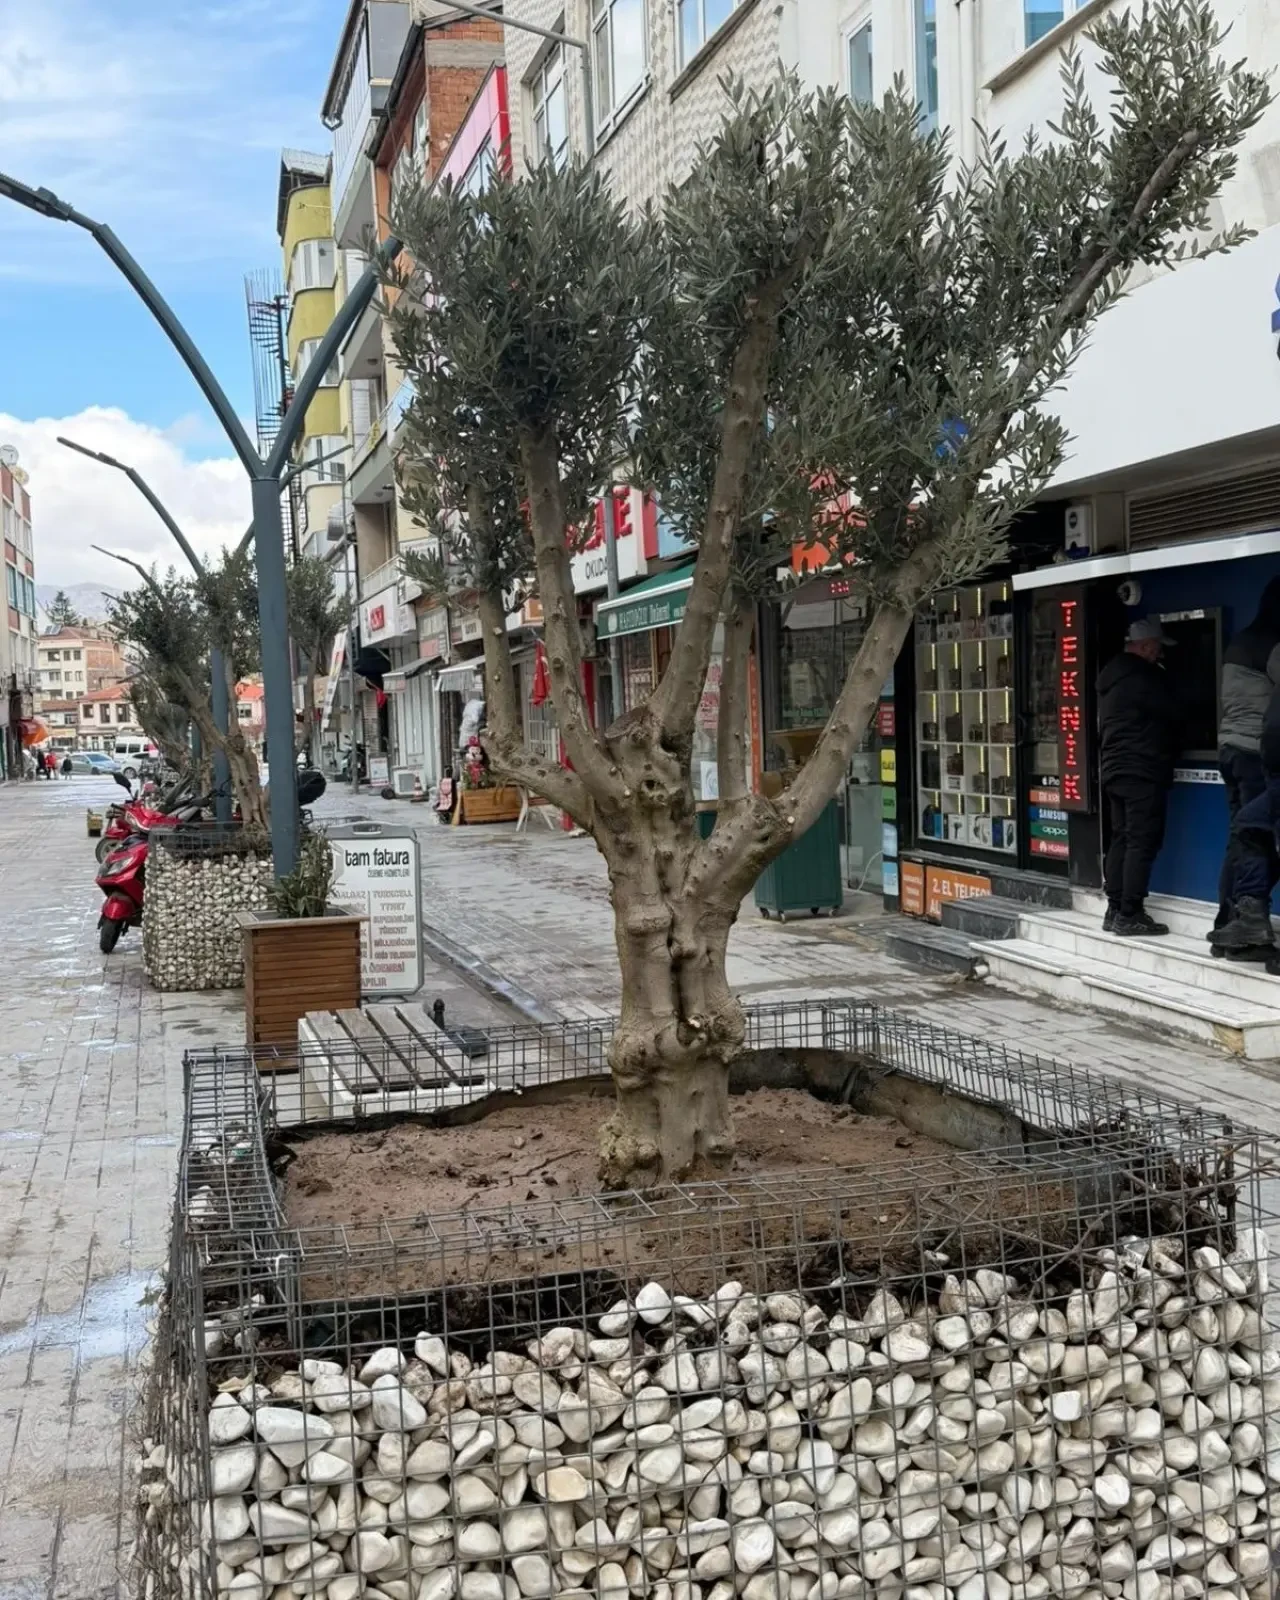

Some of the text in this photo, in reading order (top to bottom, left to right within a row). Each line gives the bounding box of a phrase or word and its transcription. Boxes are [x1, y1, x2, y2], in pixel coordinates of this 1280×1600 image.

[1039, 809, 1068, 821] SAMSUN
[345, 848, 409, 867] tam fatura
[954, 882, 991, 899] TELEFO
[361, 977, 387, 987] APILIR
